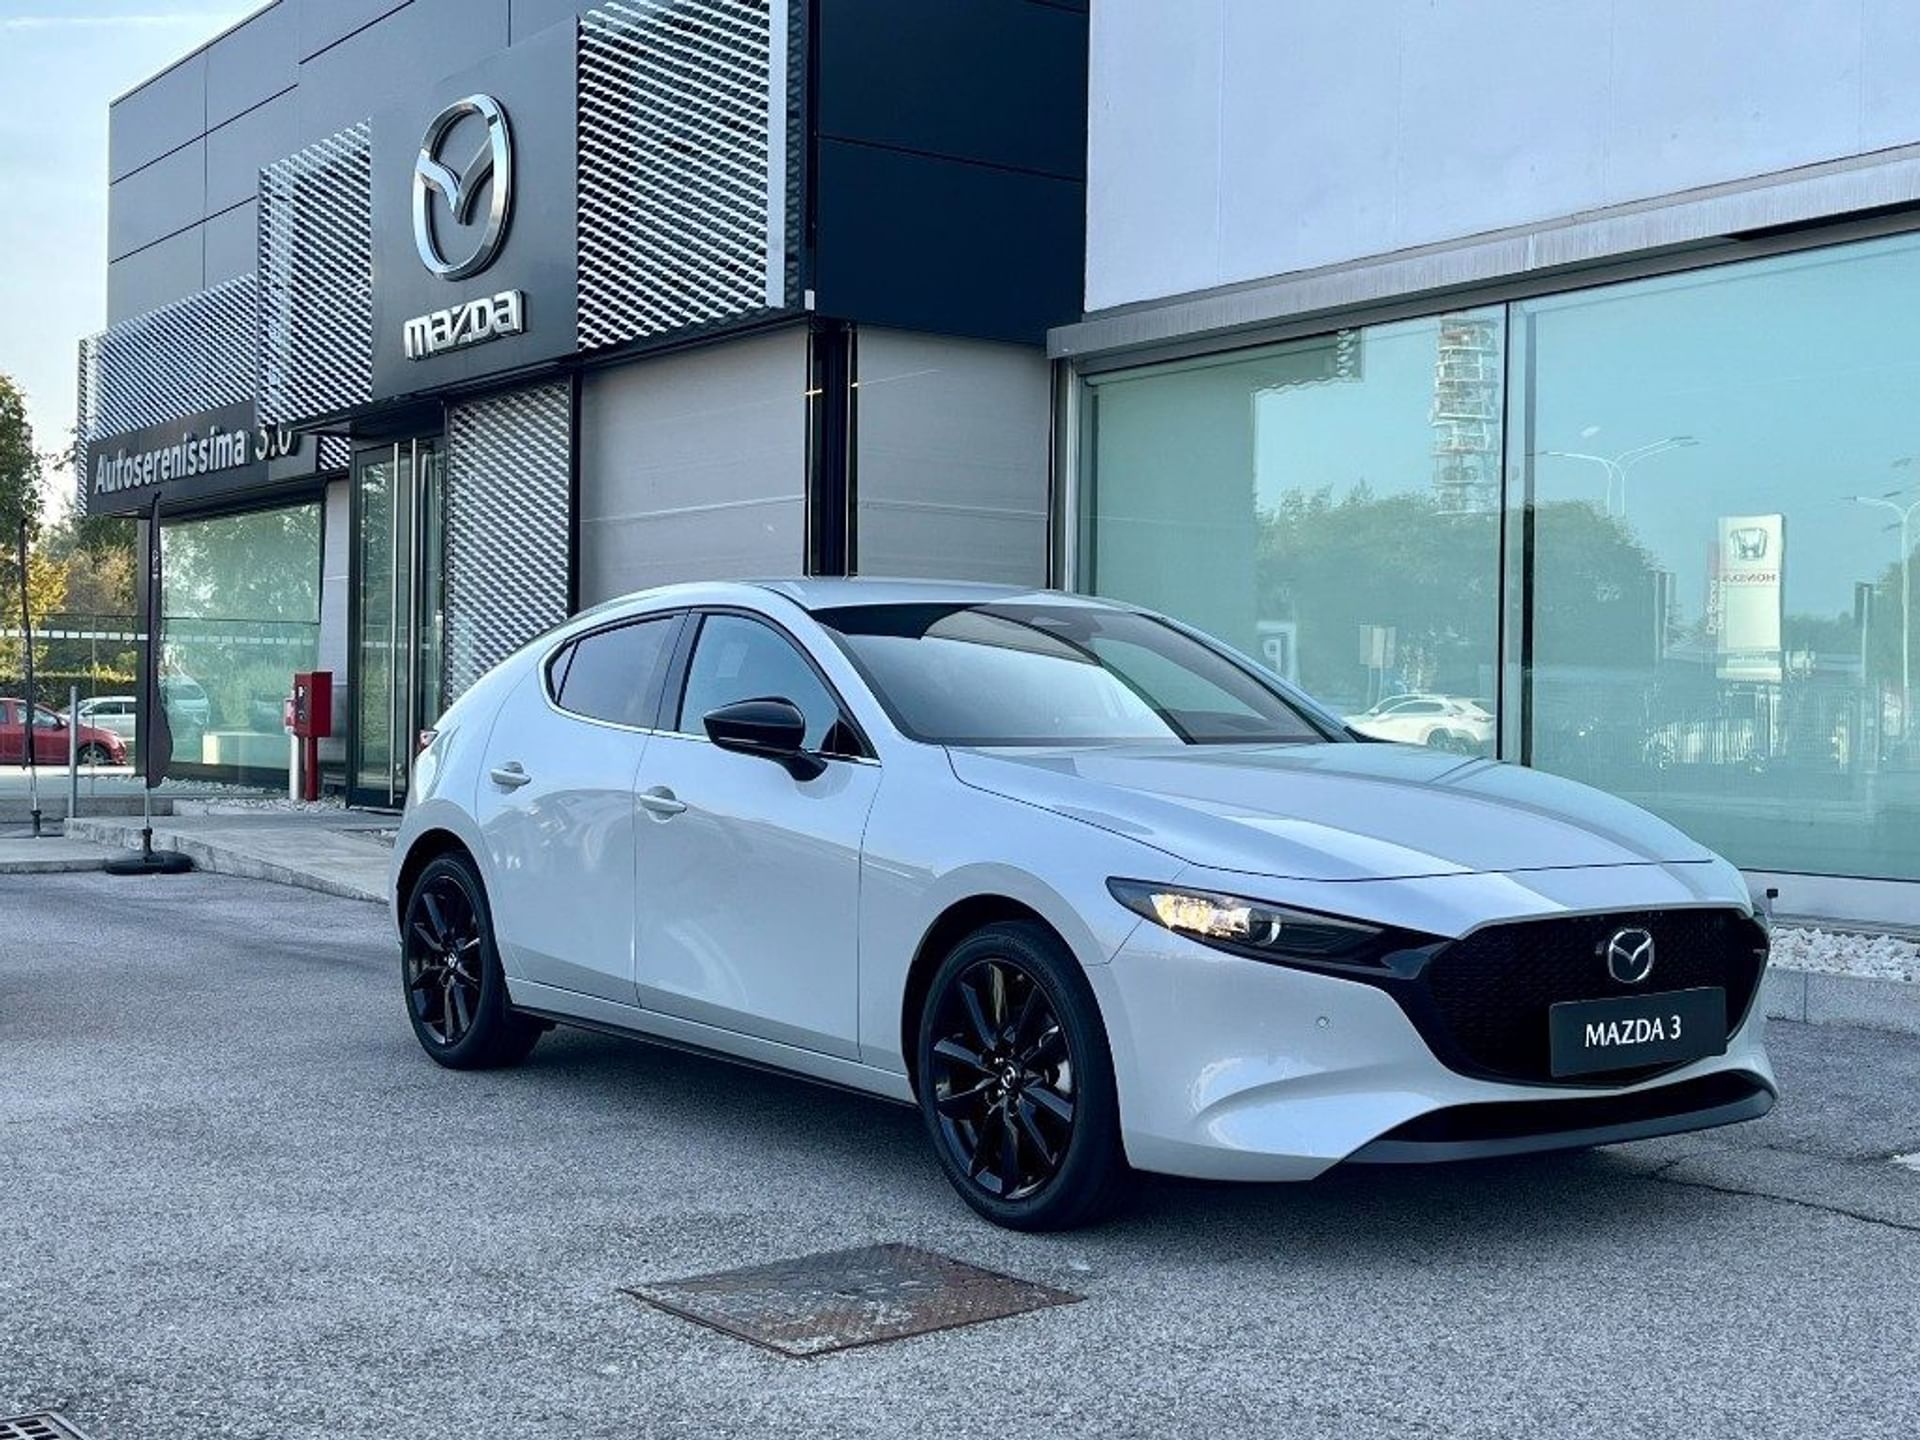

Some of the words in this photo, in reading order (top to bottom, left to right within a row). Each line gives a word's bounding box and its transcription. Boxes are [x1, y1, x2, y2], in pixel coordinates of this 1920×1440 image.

[94, 425, 246, 495] Autoserenissima
[1585, 1017, 1665, 1048] MAZDA
[1670, 1014, 1682, 1040] 3
